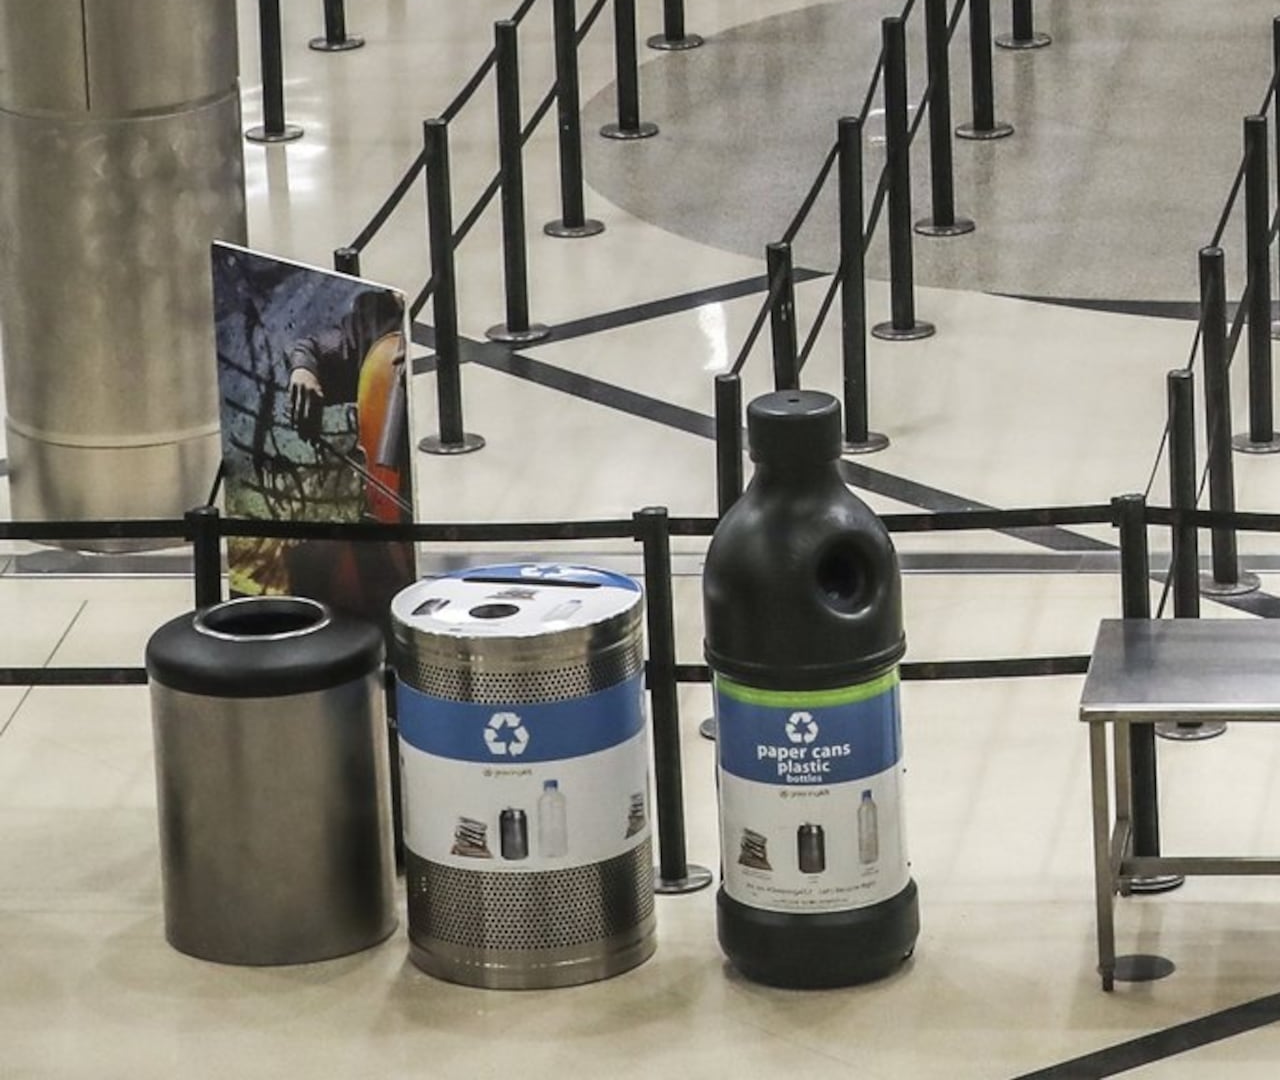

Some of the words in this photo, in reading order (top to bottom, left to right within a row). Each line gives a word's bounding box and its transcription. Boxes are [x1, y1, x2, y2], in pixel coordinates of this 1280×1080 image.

[756, 744, 808, 761] paper
[811, 743, 852, 759] cans
[777, 760, 831, 776] plastic
[786, 774, 823, 783] bottles
